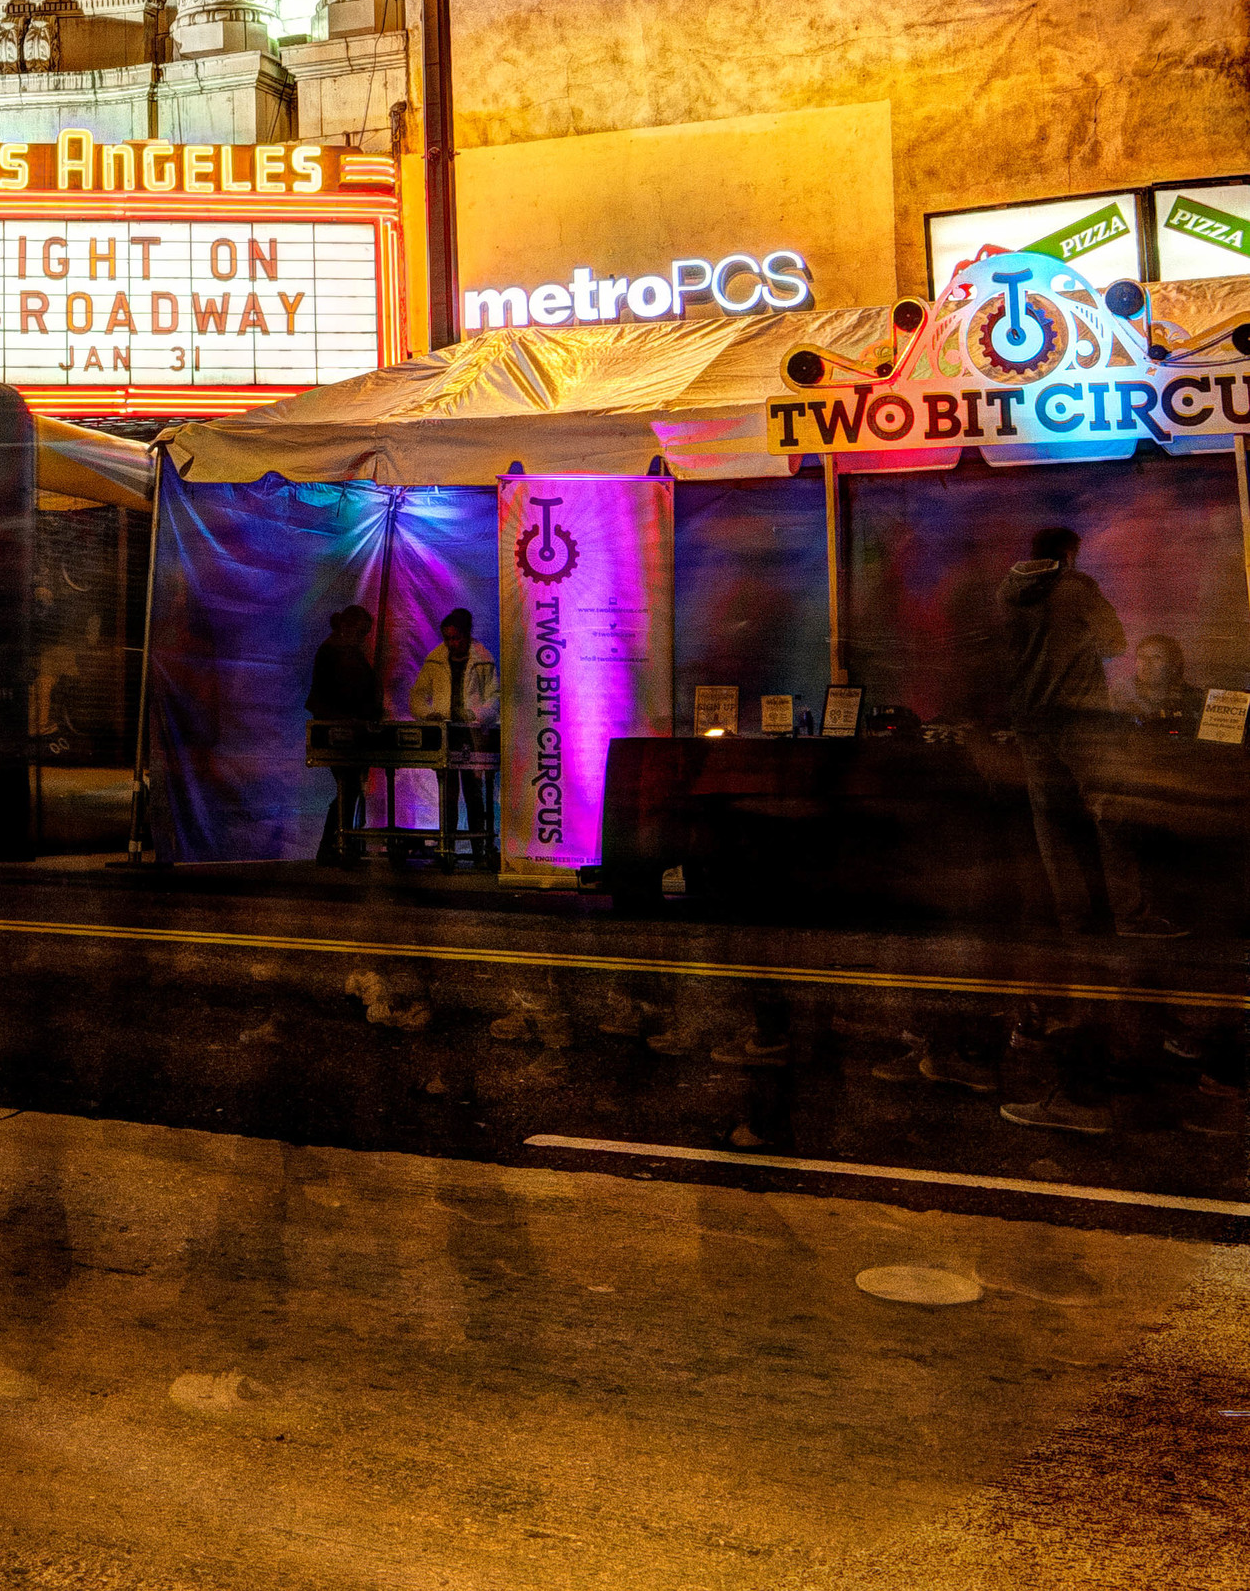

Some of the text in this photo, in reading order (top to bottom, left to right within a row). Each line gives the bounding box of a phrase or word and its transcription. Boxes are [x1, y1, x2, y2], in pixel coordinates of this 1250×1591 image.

[1059, 212, 1128, 259] PIZZA
[1172, 206, 1245, 249] PIZZA
[210, 237, 279, 282] ON
[464, 250, 809, 329] metroPCS
[58, 345, 200, 372] JAN 31
[770, 384, 914, 447] TWO
[922, 388, 1025, 440] BIT
[531, 596, 567, 845] TWO BIT CIRCUS
[1205, 704, 1247, 716] MERCH
[534, 855, 585, 864] ENGINEERING
